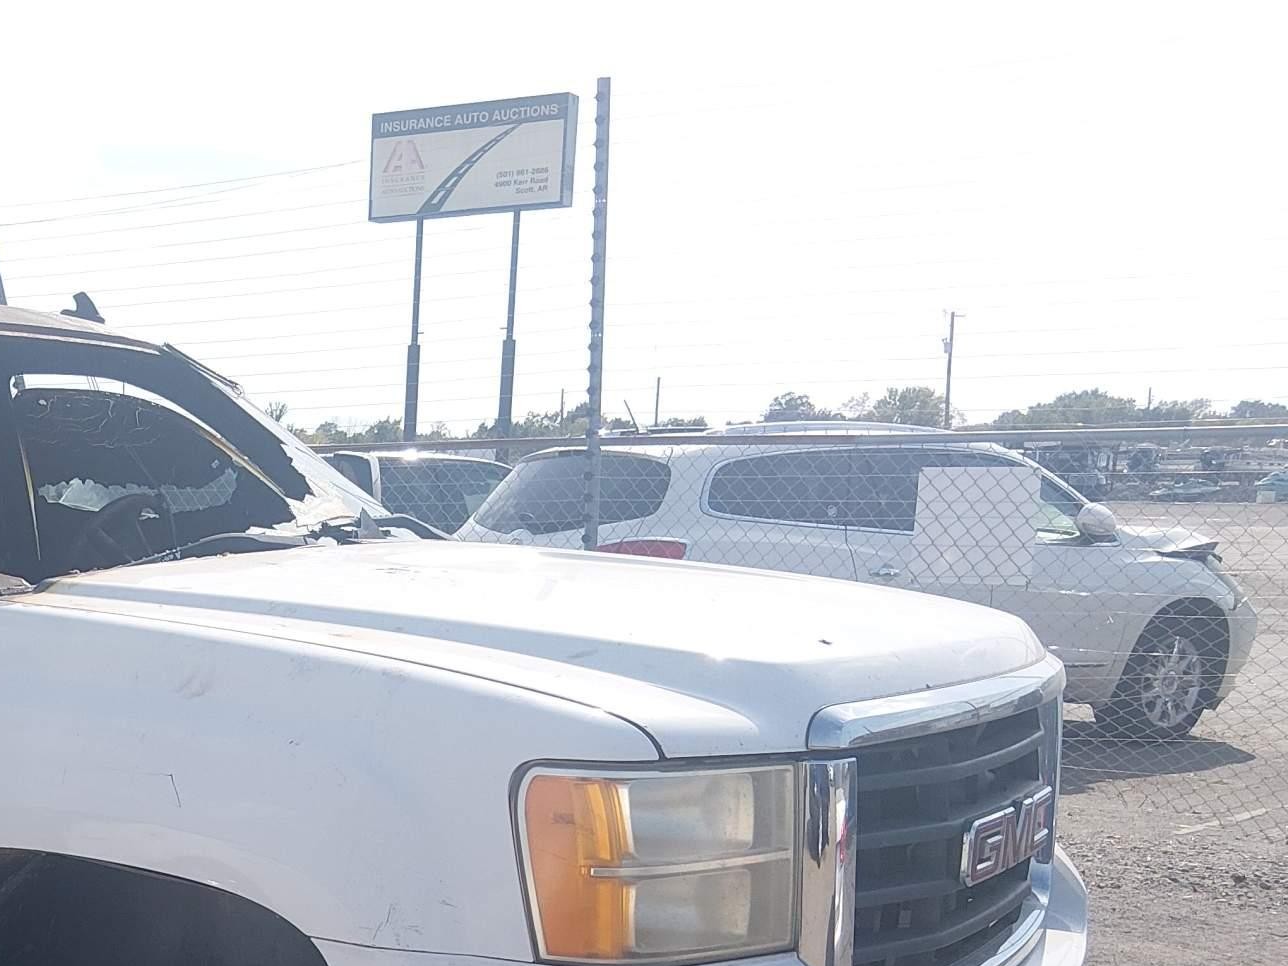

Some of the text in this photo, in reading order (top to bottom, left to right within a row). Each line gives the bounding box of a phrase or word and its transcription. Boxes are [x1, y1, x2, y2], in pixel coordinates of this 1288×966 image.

[380, 103, 559, 133] INSURANCE AUTO AUCTIONS
[962, 786, 1053, 888] GMC
